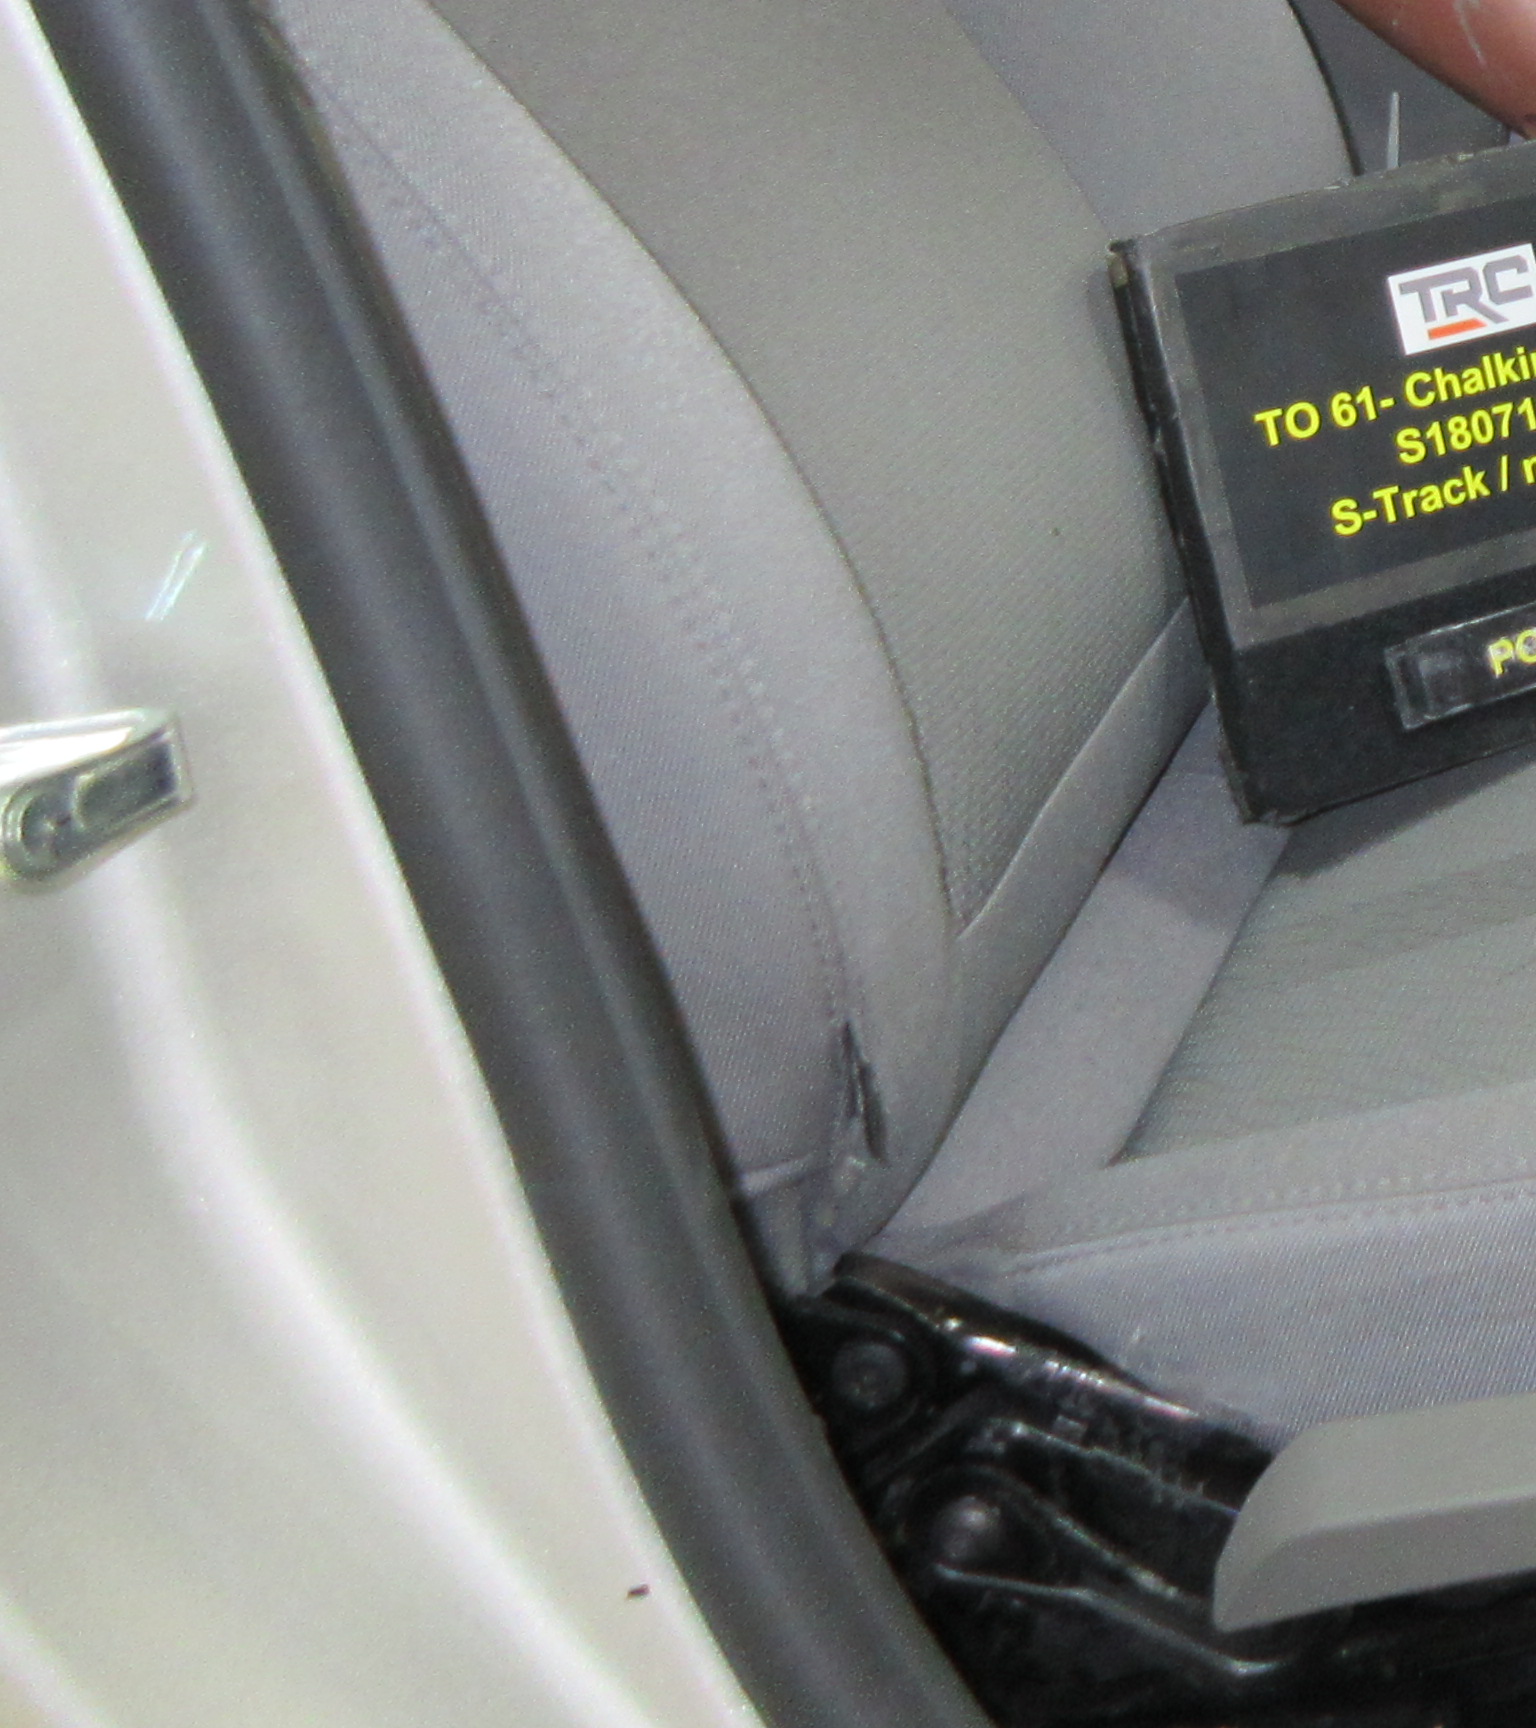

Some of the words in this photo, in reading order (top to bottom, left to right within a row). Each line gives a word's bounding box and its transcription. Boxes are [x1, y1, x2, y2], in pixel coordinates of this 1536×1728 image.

[1398, 254, 1535, 323] TRC
[1252, 398, 1323, 447] TO
[1328, 384, 1398, 430] 61-
[1328, 464, 1493, 538] S-Track
[1497, 453, 1512, 493] /
